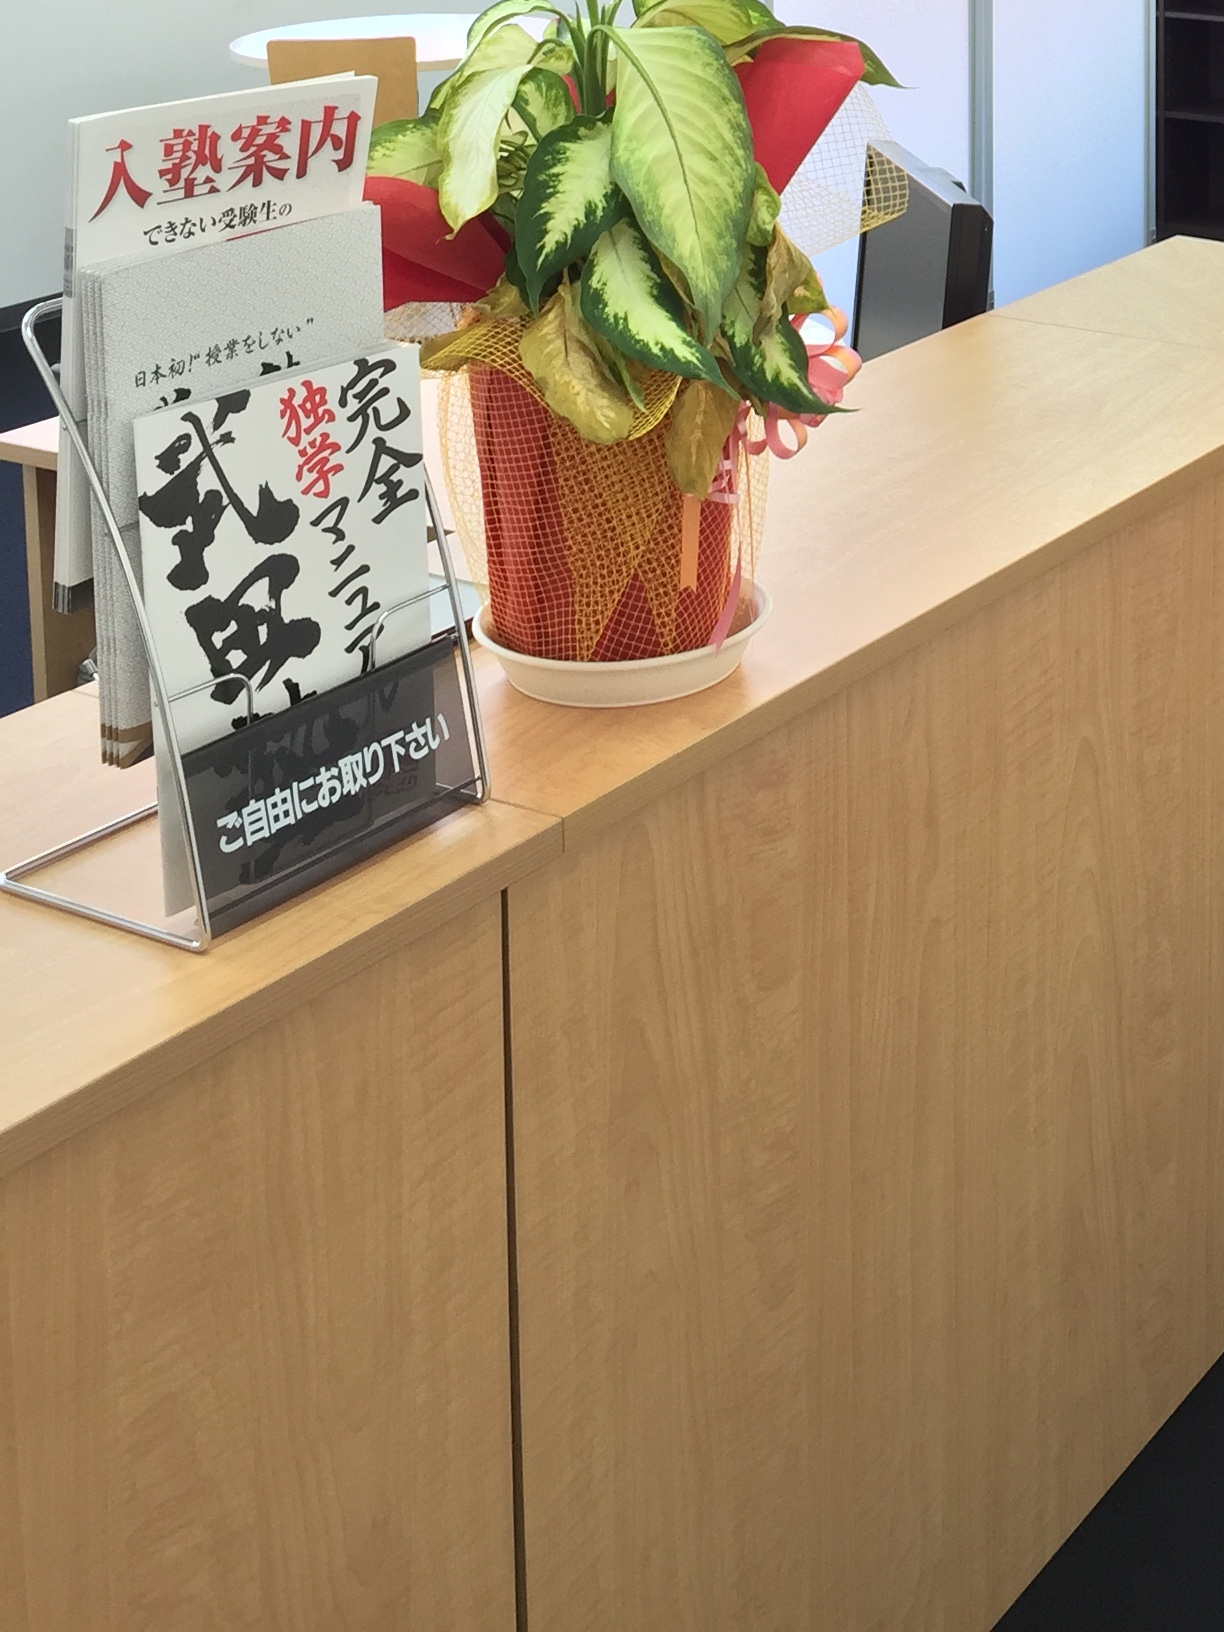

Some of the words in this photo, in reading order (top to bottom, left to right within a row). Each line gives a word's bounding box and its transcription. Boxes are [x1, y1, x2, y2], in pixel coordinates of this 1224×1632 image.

[88, 105, 362, 224] 入塾案内
[142, 199, 293, 246] できない受験生の
[339, 357, 424, 525] 完全
[215, 713, 451, 855] ご自由にお取り下さい
